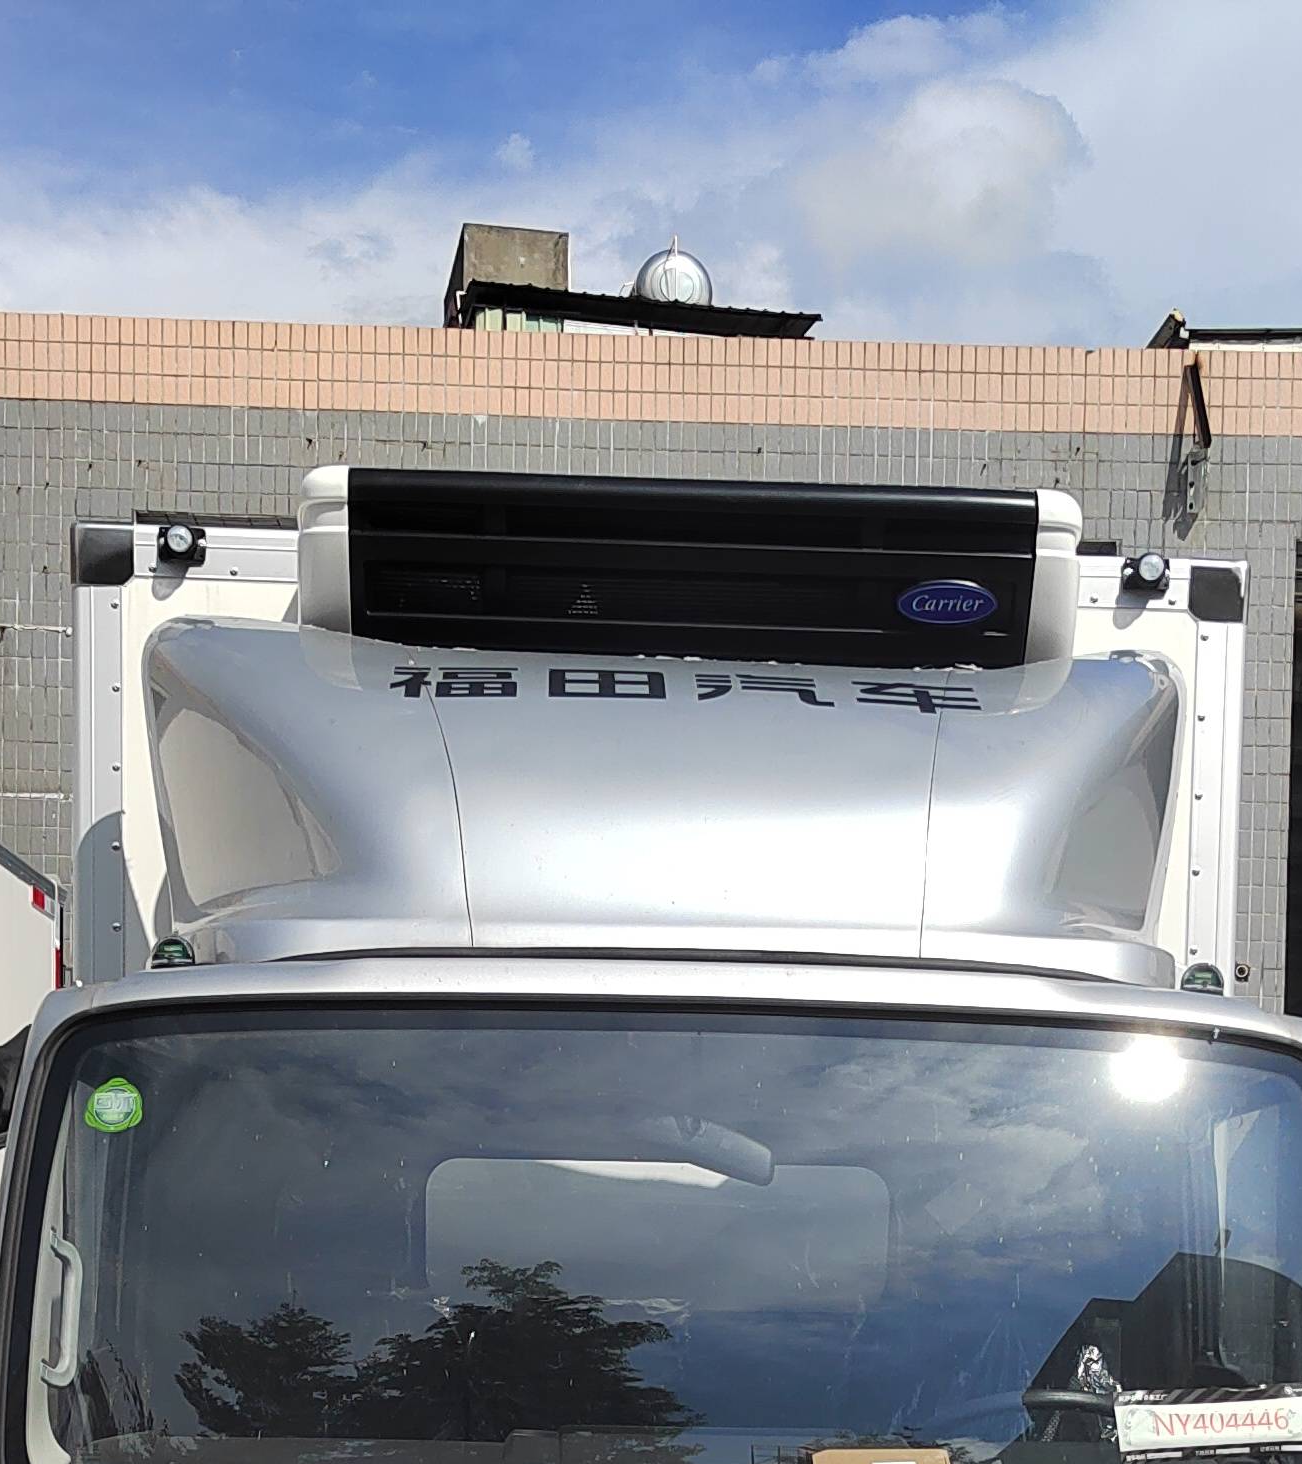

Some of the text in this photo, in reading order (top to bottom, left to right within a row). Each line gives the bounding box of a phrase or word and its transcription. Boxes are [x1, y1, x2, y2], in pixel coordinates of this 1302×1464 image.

[912, 594, 983, 612] Carrier
[390, 666, 982, 714] 福田汽车
